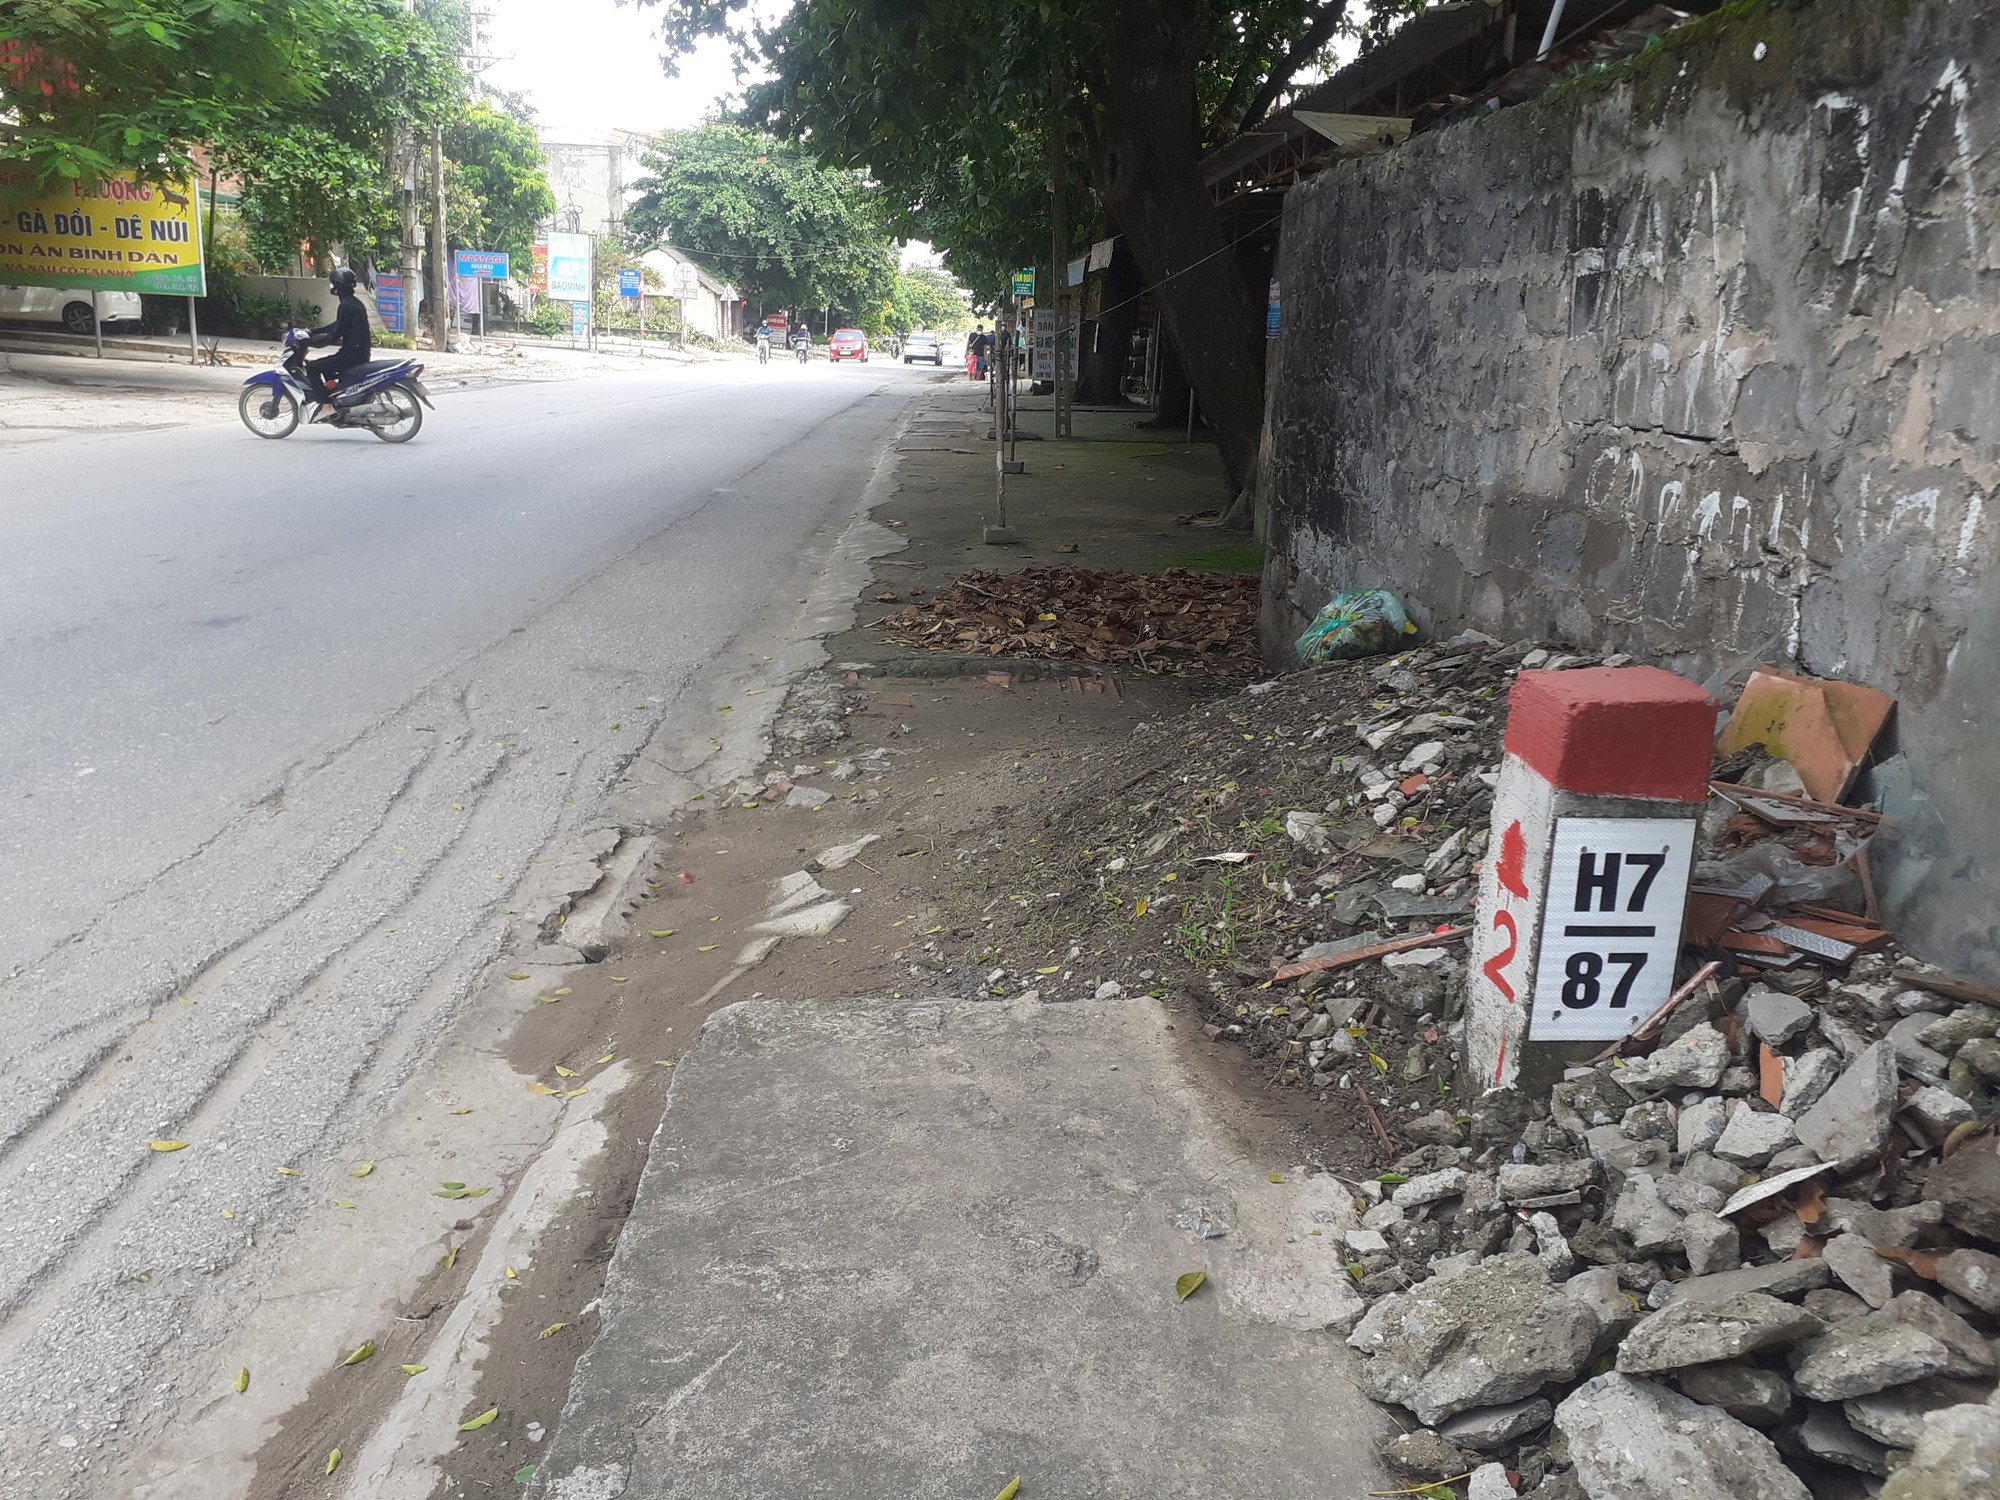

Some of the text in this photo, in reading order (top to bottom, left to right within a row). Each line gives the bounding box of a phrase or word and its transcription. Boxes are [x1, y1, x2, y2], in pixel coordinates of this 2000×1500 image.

[18, 207, 48, 235] GÀ
[54, 207, 92, 237] ĐỒI
[115, 214, 143, 240] DÊ
[151, 217, 188, 243] NÚI
[69, 245, 122, 262] BÌNH
[128, 250, 178, 265] DÂN
[460, 254, 504, 264] MASSAGE
[1037, 319, 1054, 332] BÁN
[1574, 853, 1666, 912] H7
[1561, 952, 1648, 1009] 87
